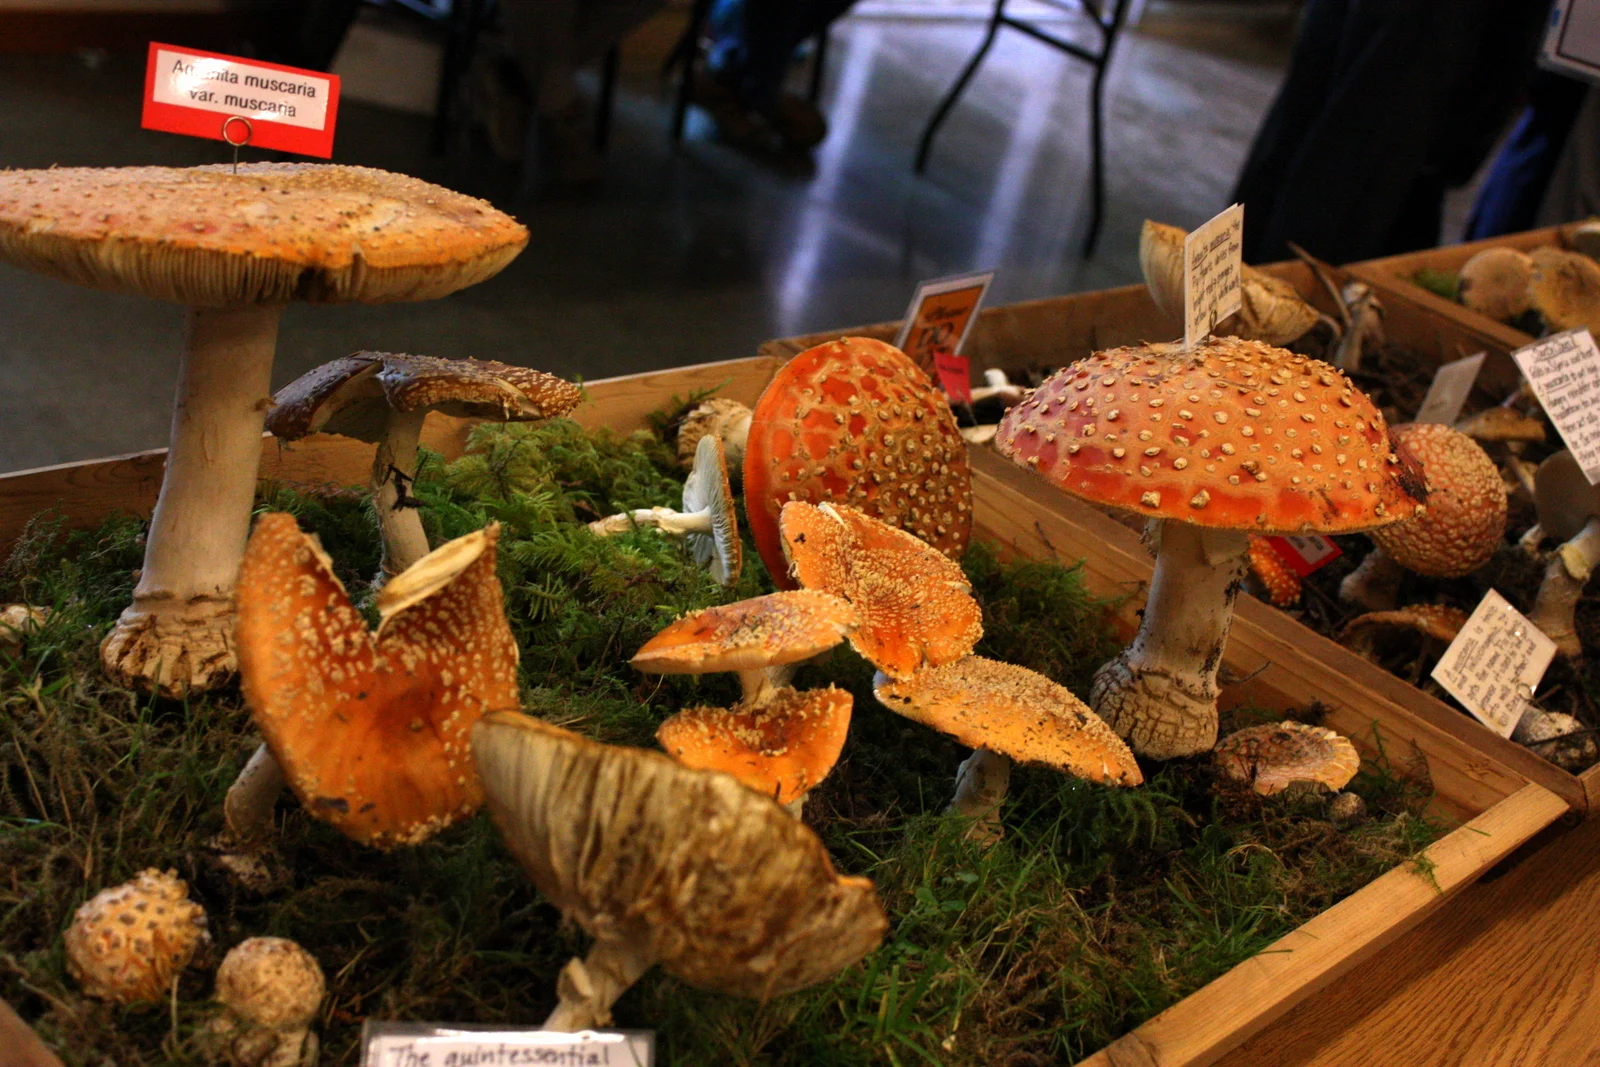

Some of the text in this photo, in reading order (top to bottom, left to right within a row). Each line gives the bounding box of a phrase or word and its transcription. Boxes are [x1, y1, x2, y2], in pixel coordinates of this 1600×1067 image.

[172, 59, 316, 98] Amnita muscaria
[189, 90, 297, 118] var. muscaria
[1453, 638, 1477, 671] muscaria
[390, 1045, 431, 1067] The
